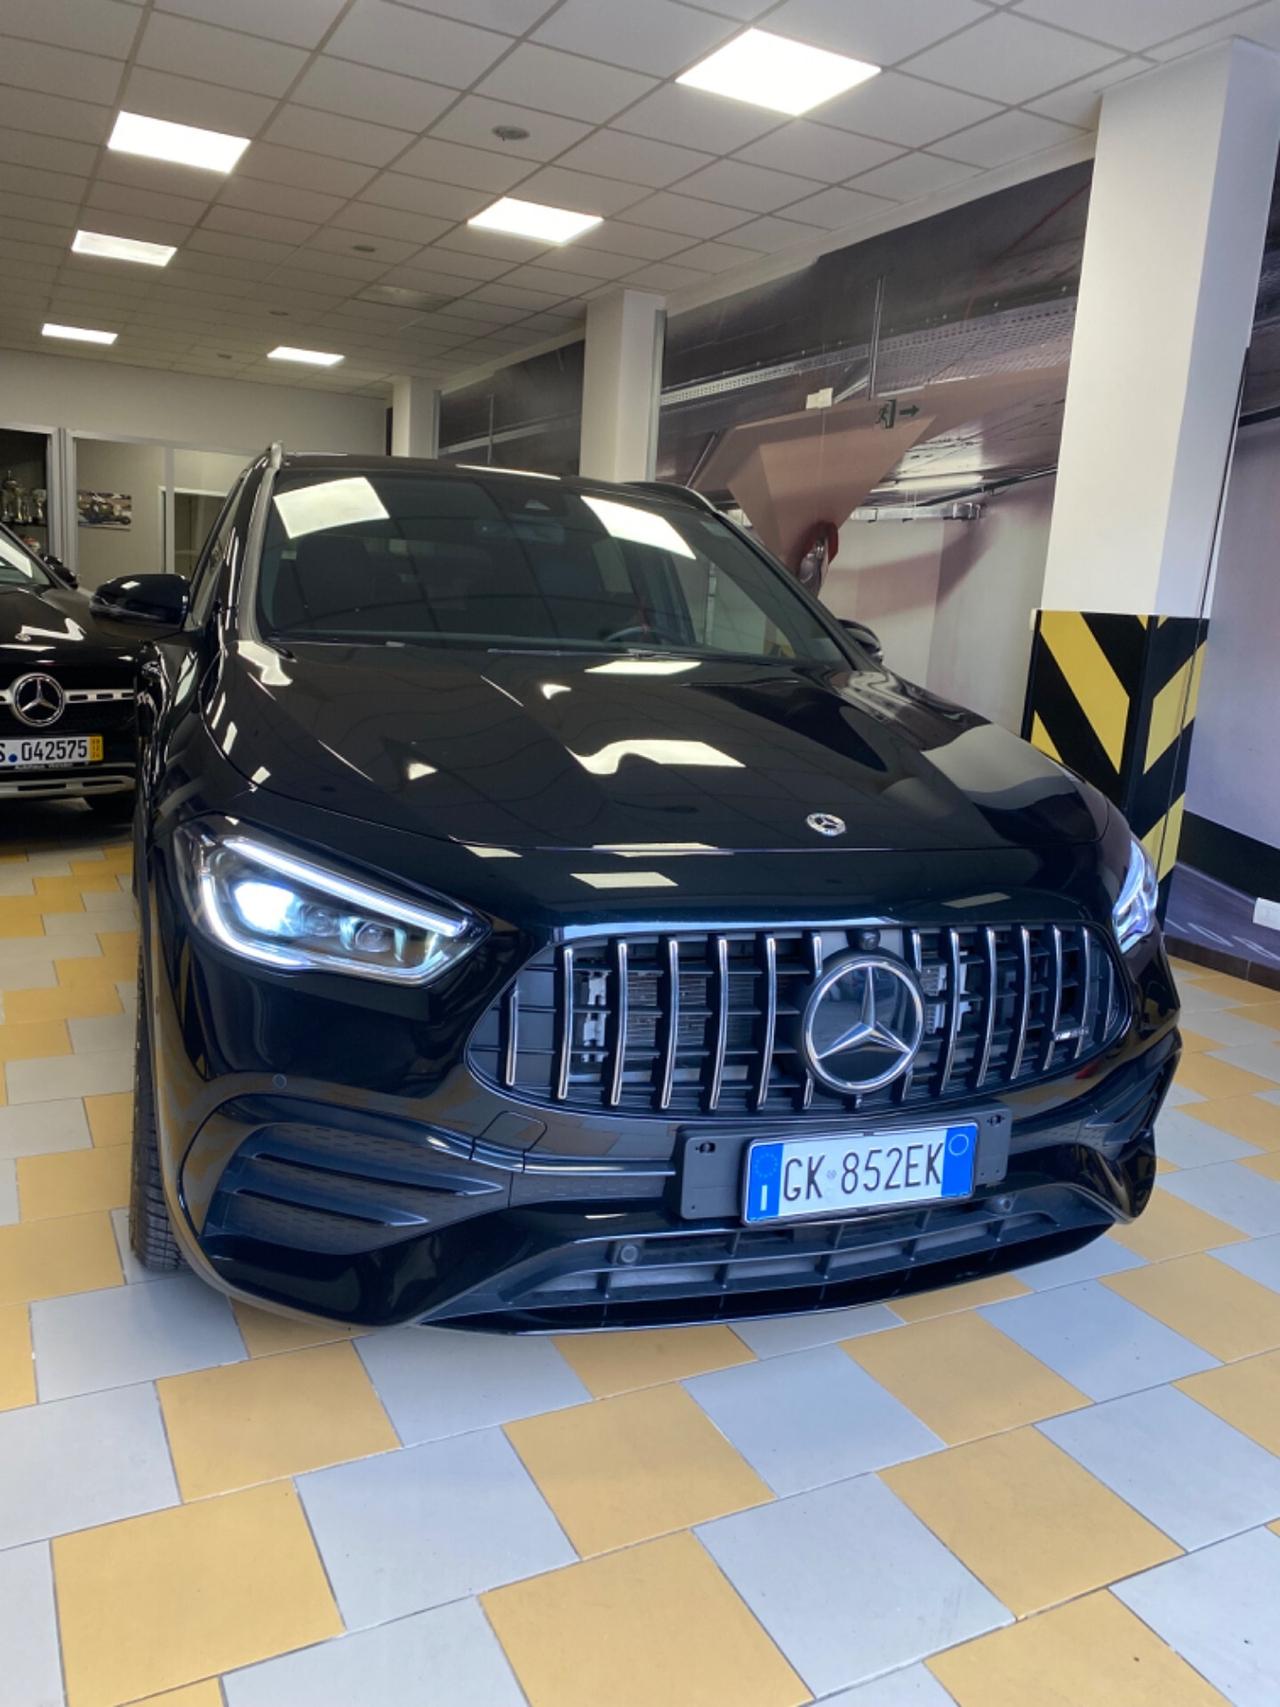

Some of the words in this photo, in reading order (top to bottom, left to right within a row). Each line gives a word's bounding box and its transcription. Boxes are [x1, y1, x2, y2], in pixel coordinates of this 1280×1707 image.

[21, 739, 87, 761] 042575
[783, 1155, 826, 1201] GK
[840, 1142, 944, 1195] 852EK
